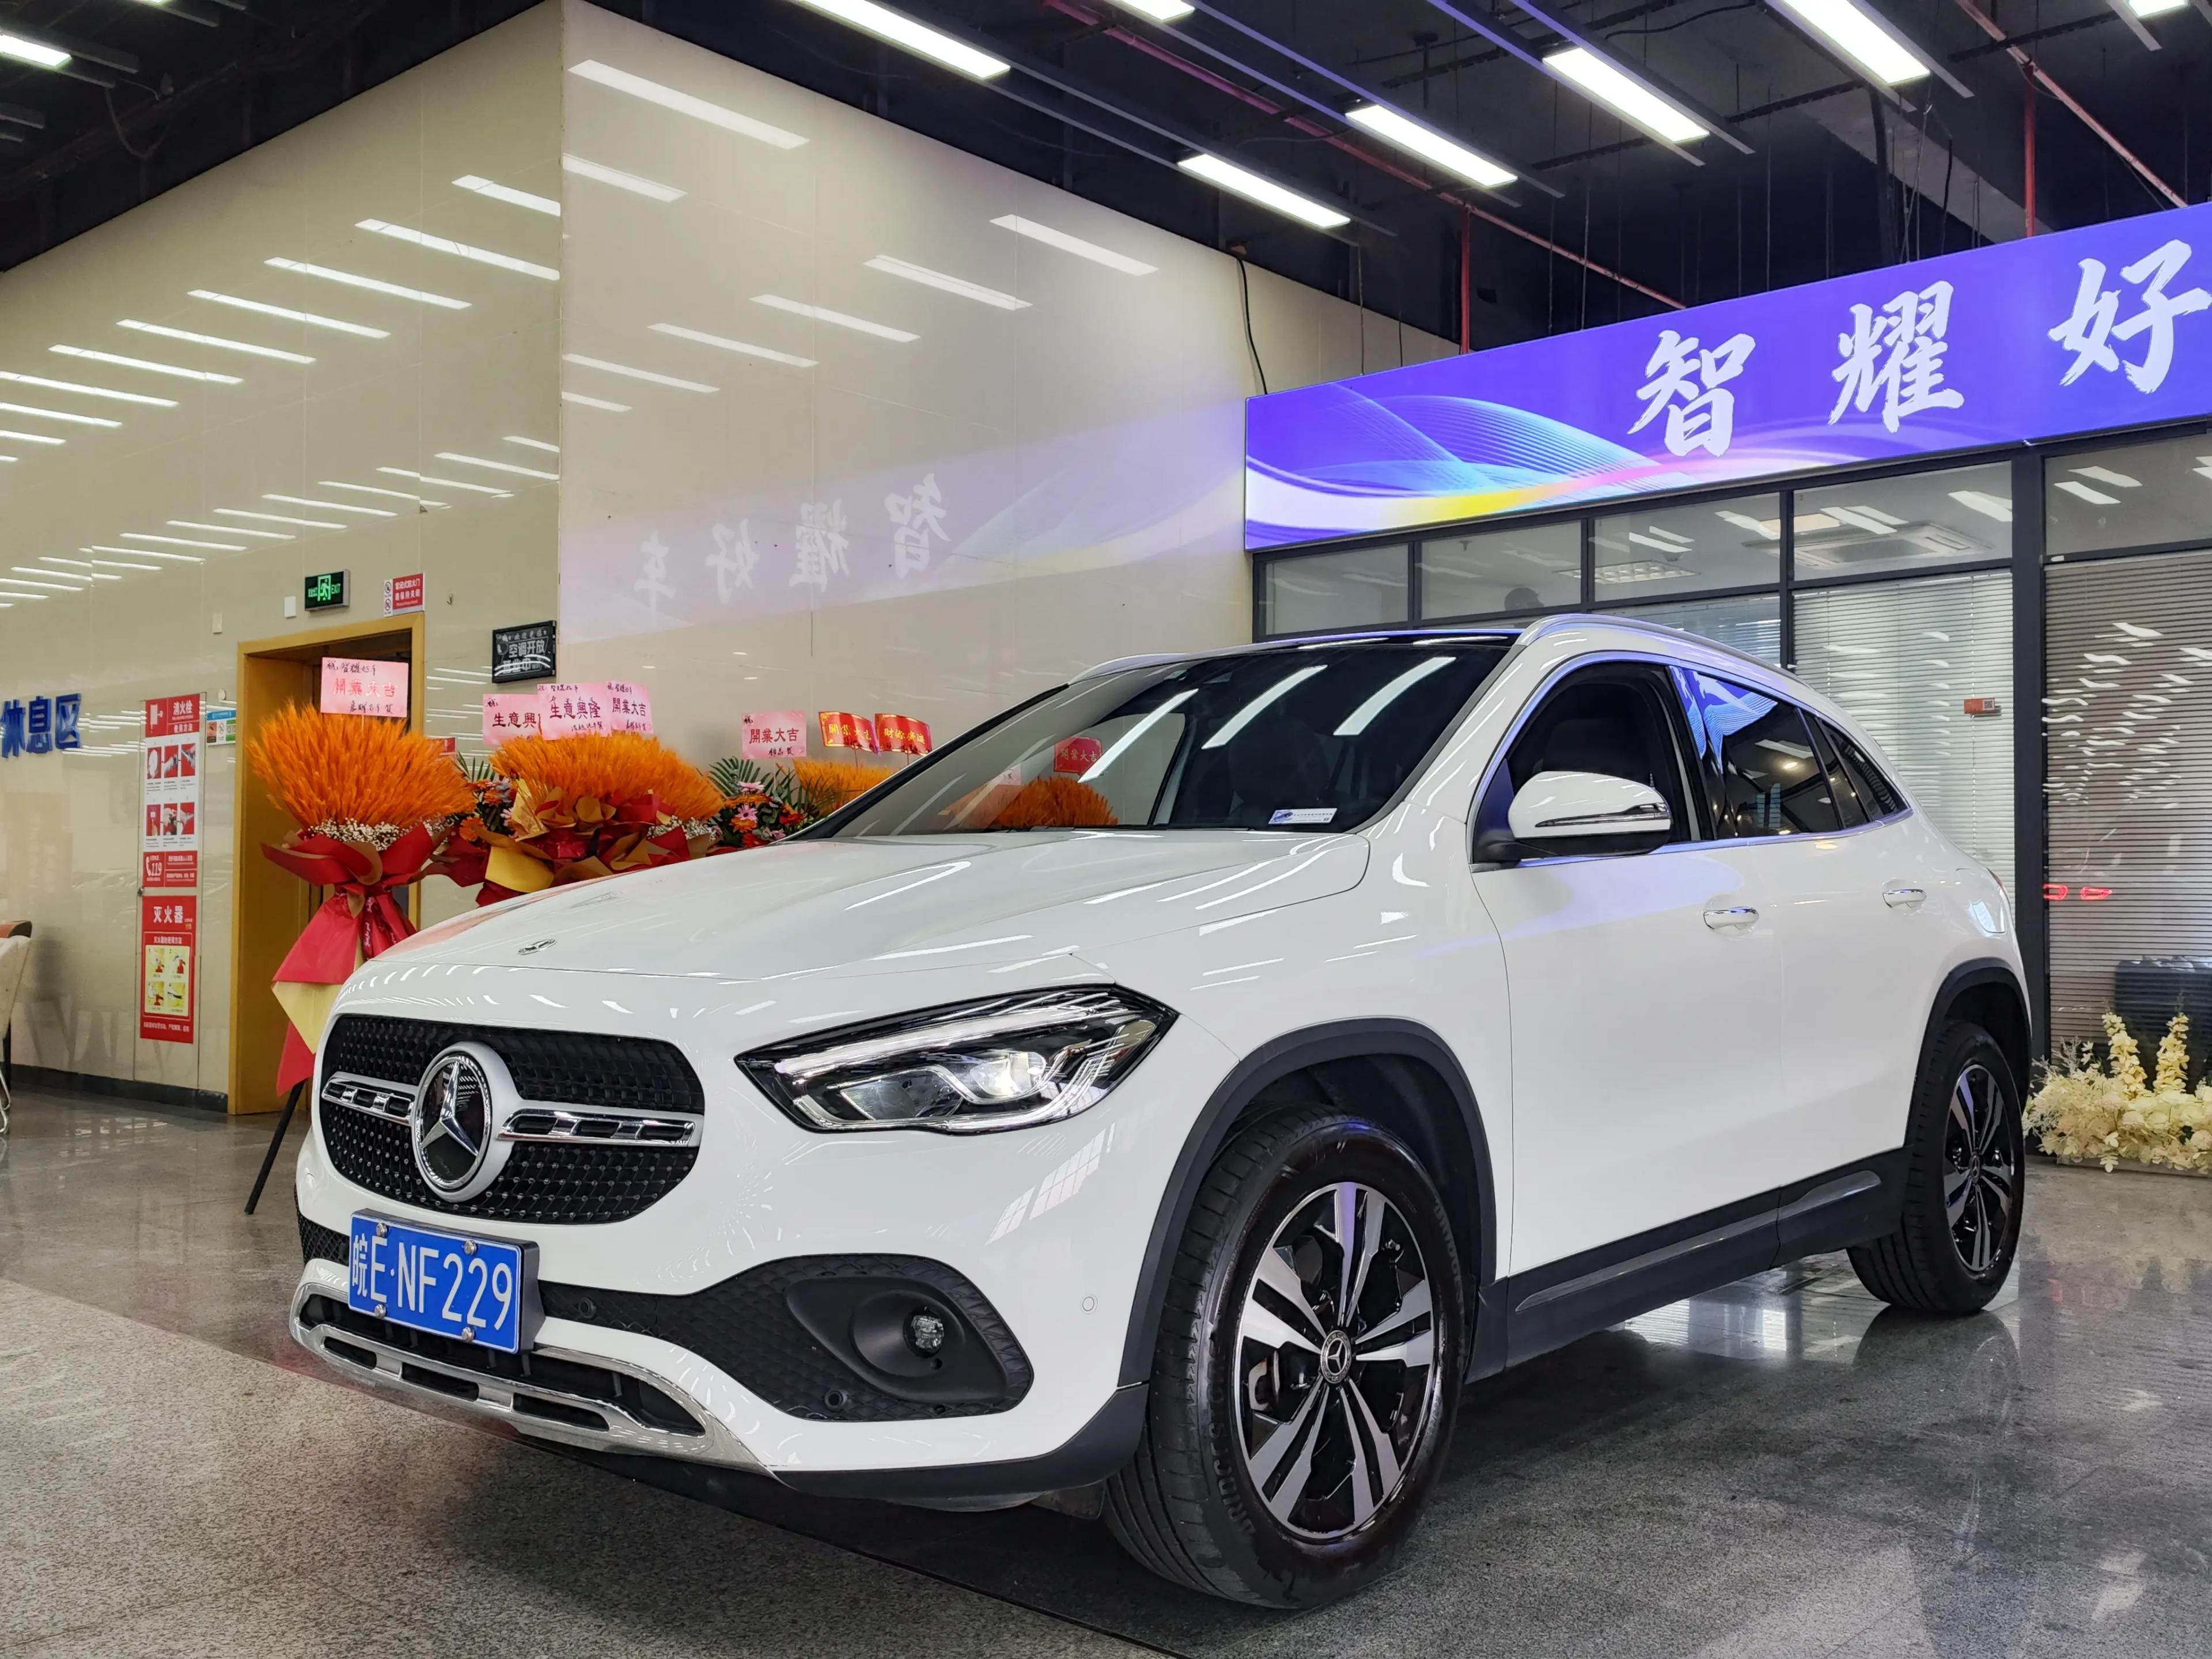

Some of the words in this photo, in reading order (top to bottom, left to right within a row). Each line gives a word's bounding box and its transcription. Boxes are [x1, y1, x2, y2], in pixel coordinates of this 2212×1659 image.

[1628, 239, 2212, 456] 智耀好
[509, 639, 546, 658] 空调开放
[173, 700, 193, 715] 消火栓
[550, 701, 601, 719] 生意興隆
[612, 698, 646, 717] 開業大吉
[0, 693, 81, 758] 休息区
[492, 711, 543, 729] 生意興
[749, 728, 799, 744] 開業大吉
[151, 862, 162, 876] 119
[153, 905, 183, 924] 灭火器
